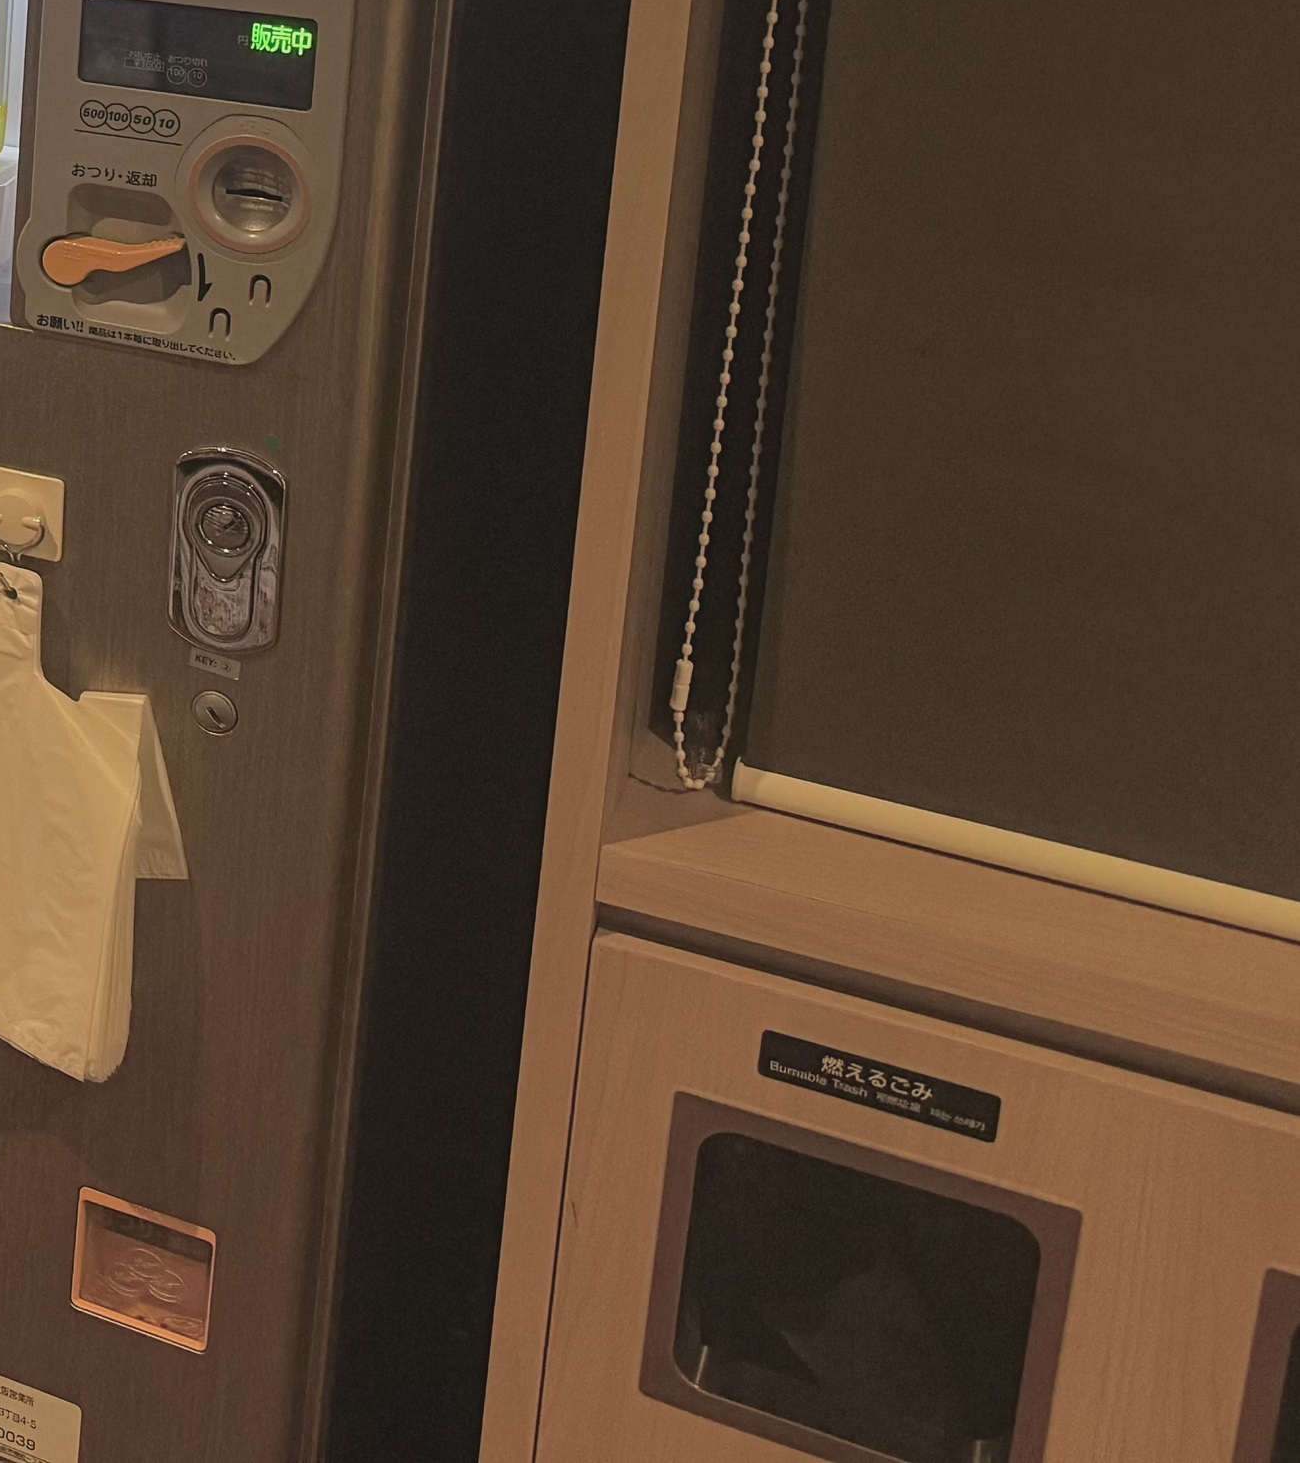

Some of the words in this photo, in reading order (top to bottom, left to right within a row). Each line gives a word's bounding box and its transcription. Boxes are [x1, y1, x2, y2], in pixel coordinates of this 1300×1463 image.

[251, 22, 312, 56] 販売中
[83, 105, 105, 119] 500
[108, 110, 130, 124] 100
[133, 114, 152, 126] 50
[158, 117, 176, 130] 10
[769, 1060, 827, 1086] Burnable
[833, 1078, 868, 1098] Trash
[821, 1055, 933, 1101] 燃えるごみ
